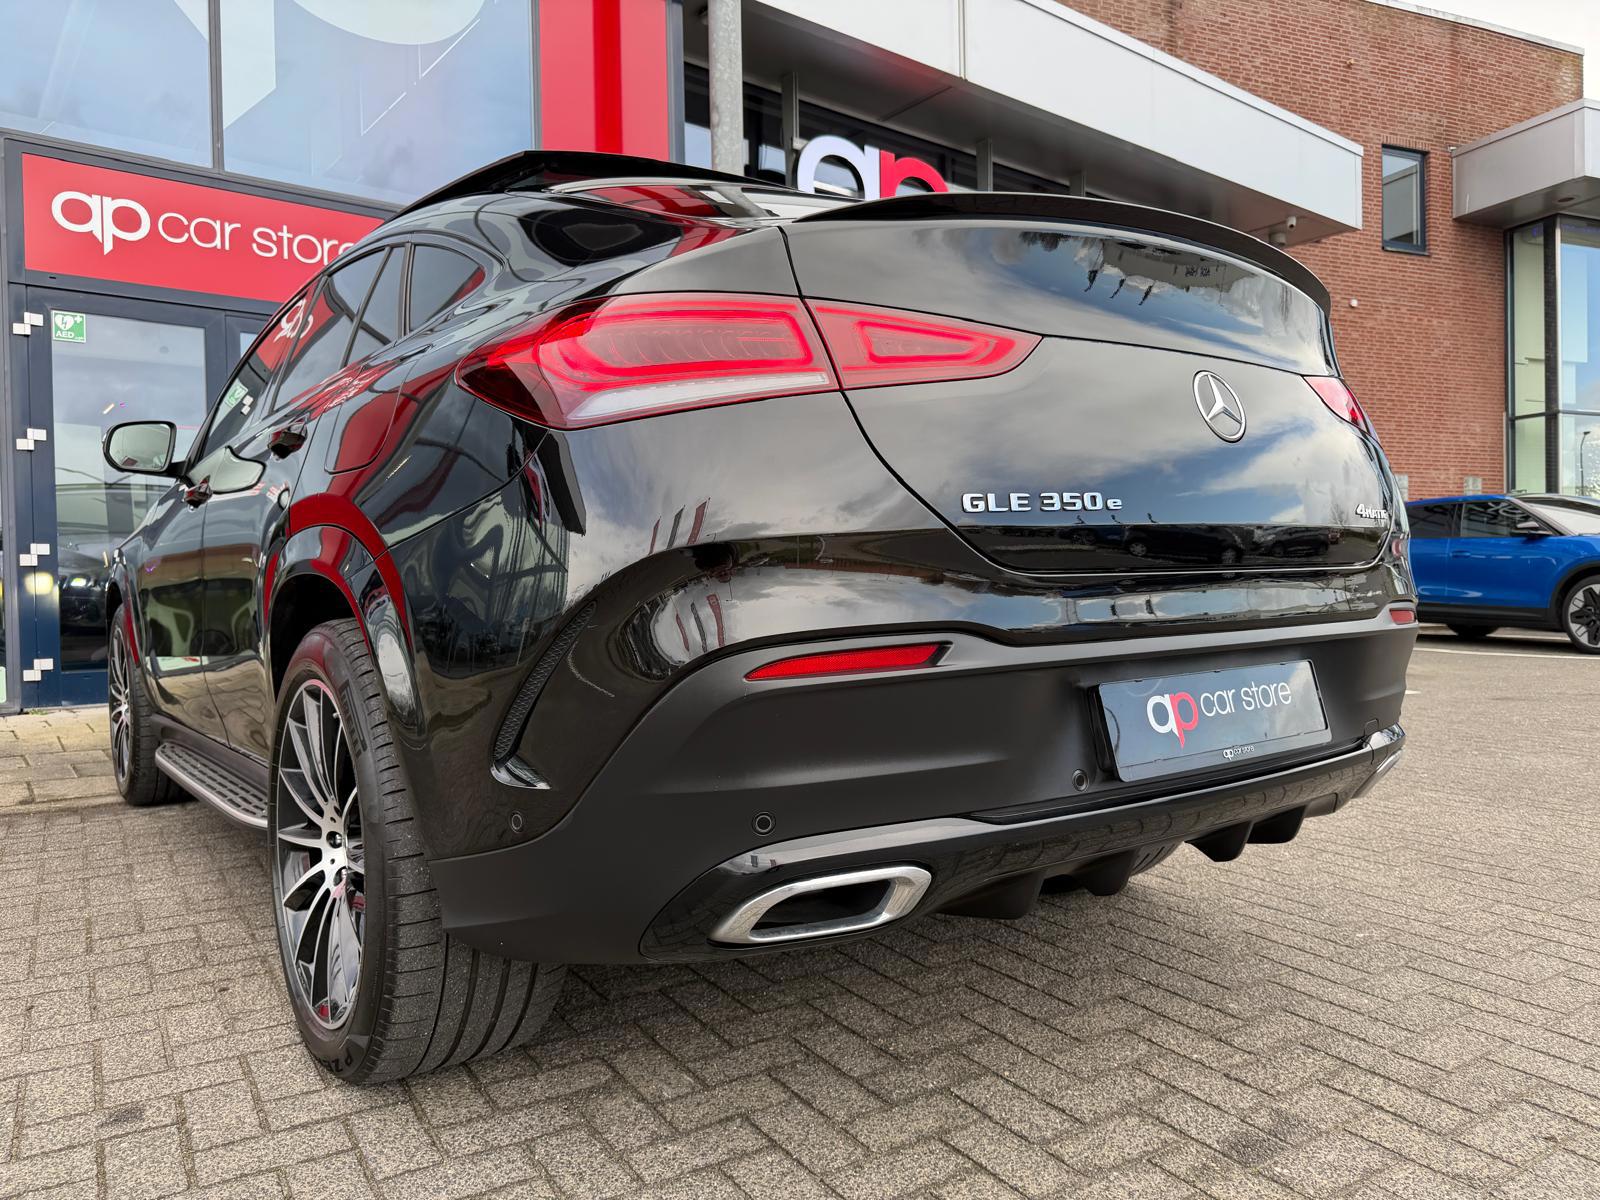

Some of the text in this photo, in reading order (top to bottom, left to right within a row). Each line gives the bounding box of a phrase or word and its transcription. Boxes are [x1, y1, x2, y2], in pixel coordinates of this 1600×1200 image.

[51, 190, 151, 255] ap
[158, 212, 241, 251] car
[56, 330, 75, 339] AED
[962, 493, 1032, 512] GLE
[1146, 681, 1292, 749] ap car store
